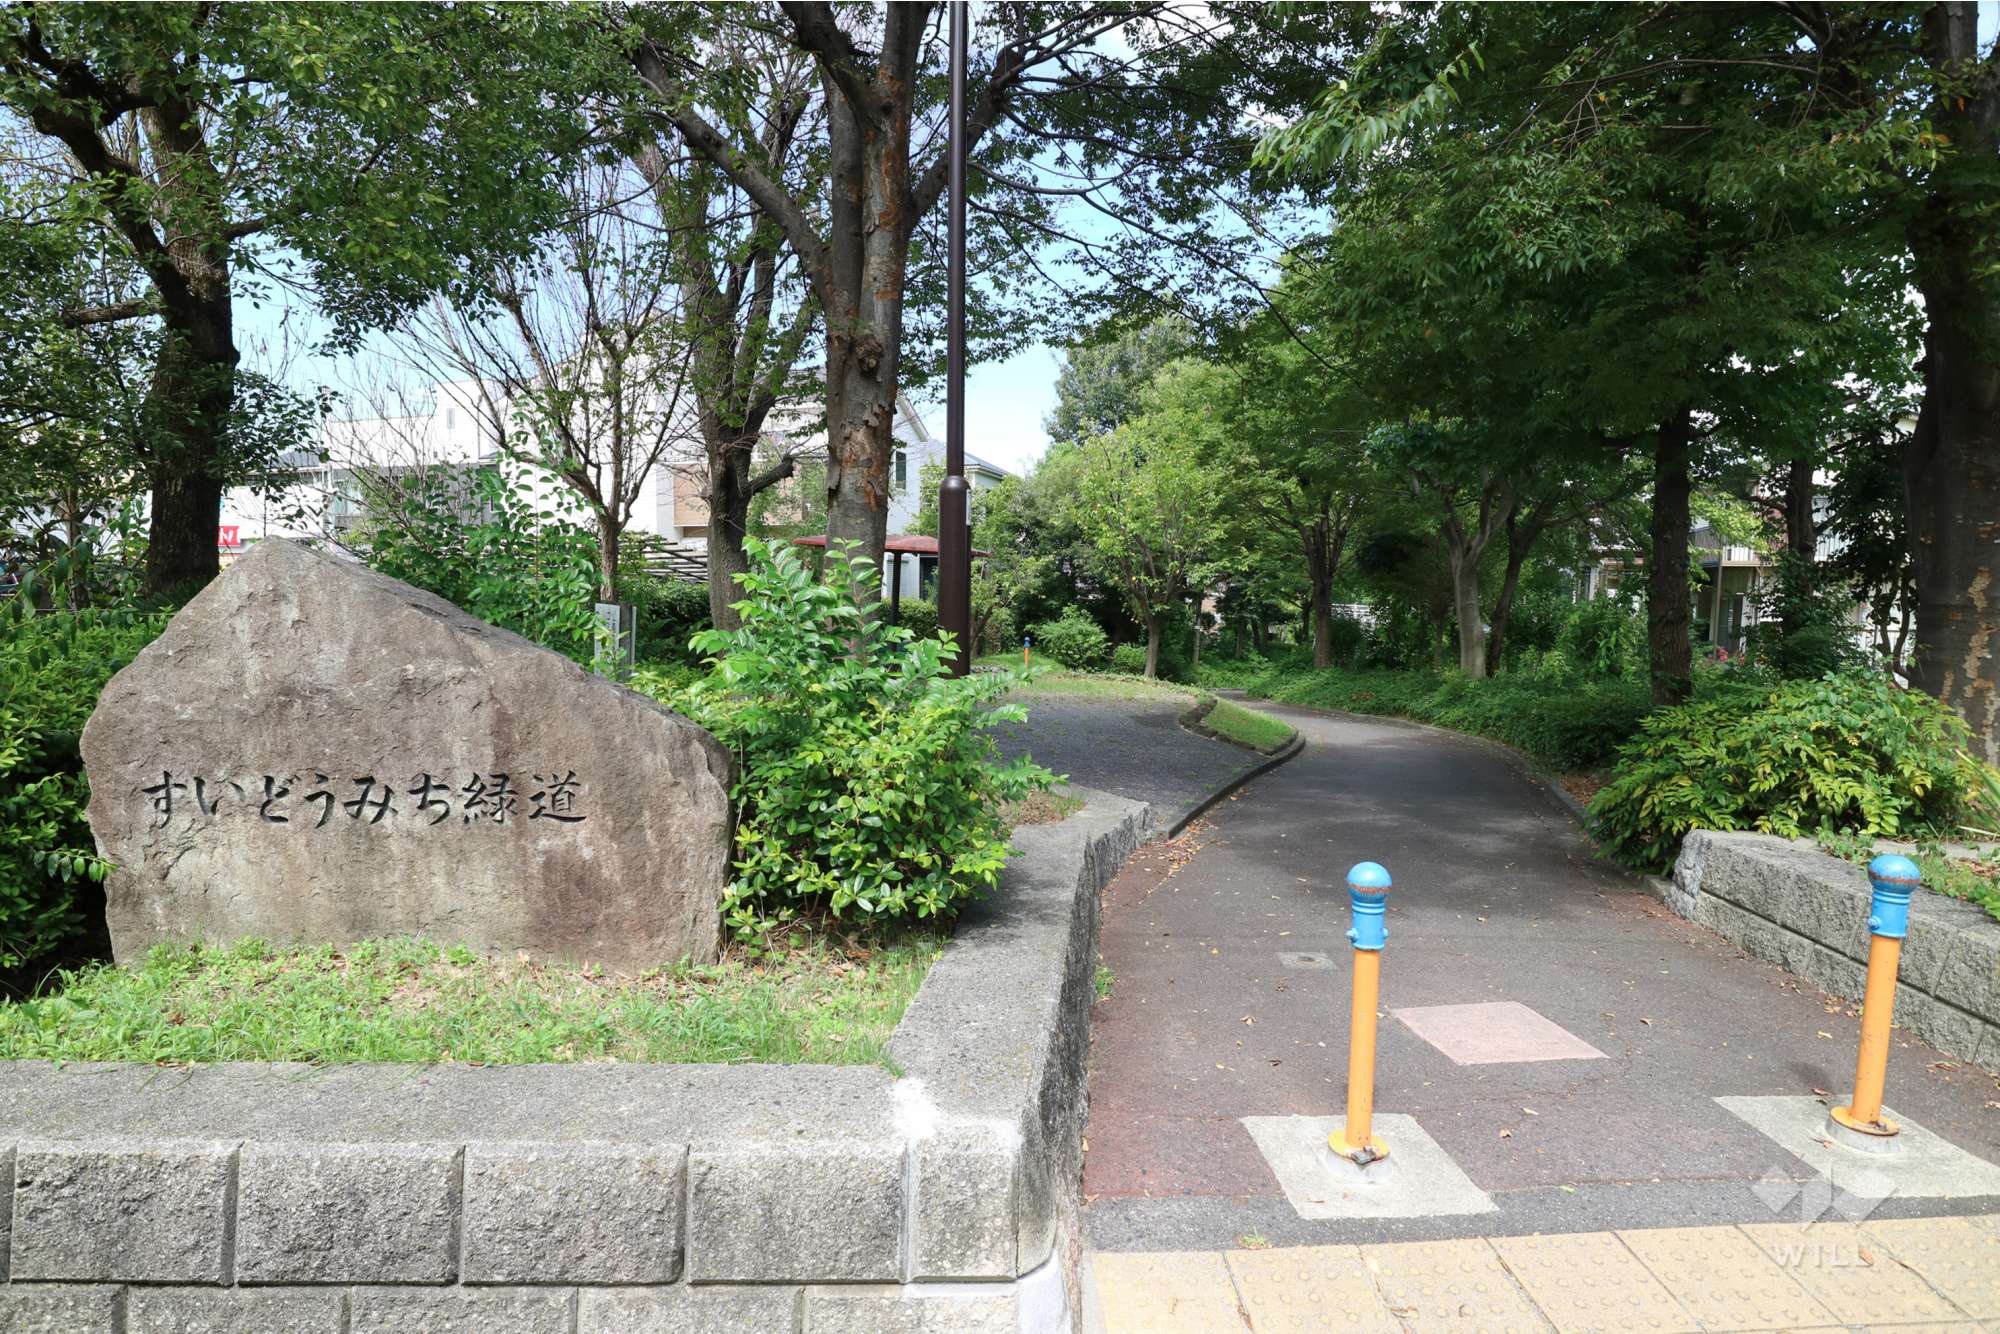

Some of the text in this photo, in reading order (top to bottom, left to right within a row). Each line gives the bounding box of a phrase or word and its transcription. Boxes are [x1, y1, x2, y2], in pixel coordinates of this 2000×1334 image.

[142, 770, 587, 829] すいどうみち緑道
